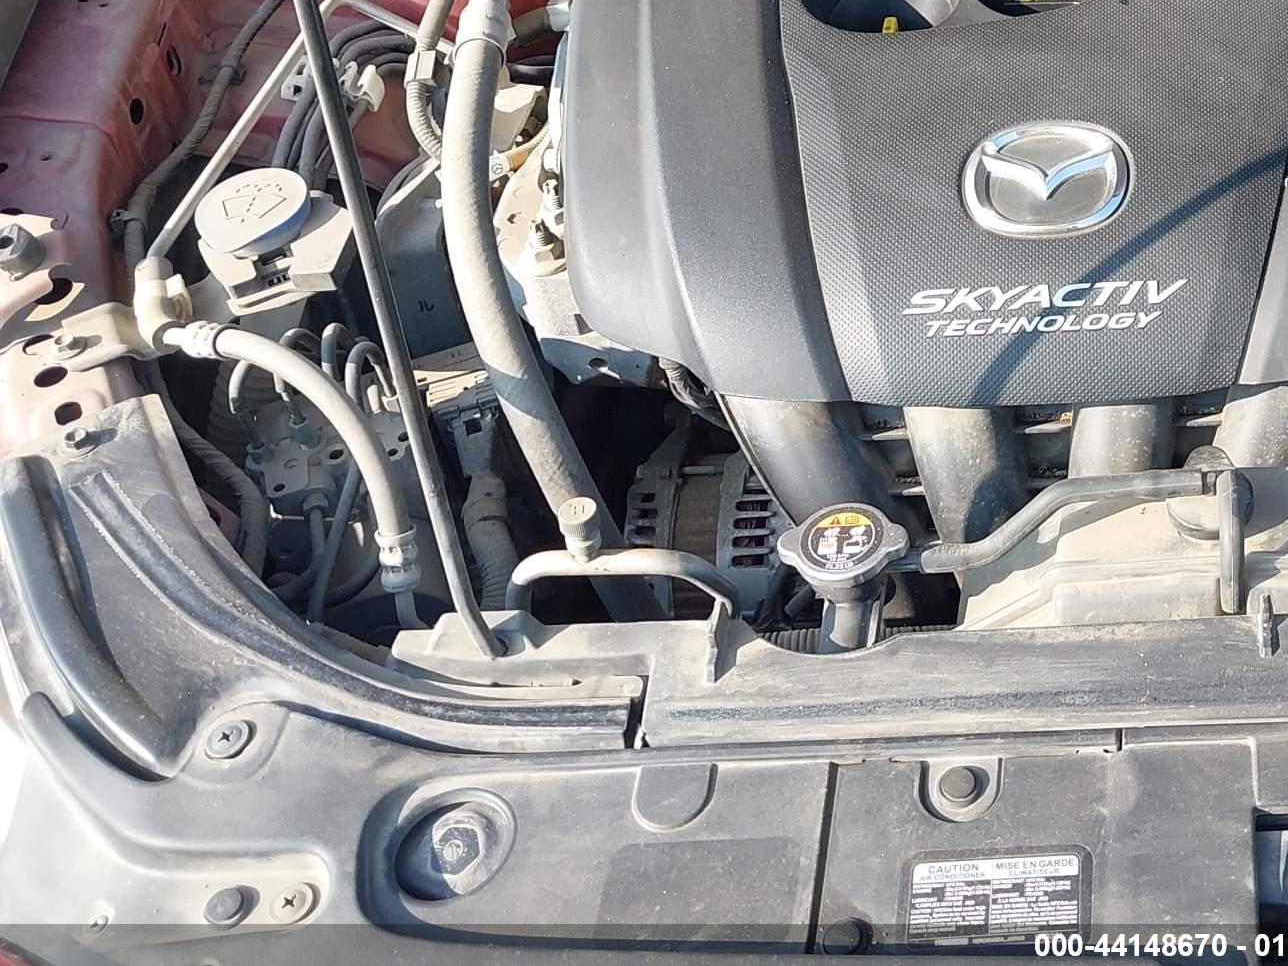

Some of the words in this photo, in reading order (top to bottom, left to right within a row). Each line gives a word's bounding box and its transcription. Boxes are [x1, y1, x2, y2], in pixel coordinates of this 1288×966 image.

[901, 278, 1190, 316] SKYACTIV
[925, 309, 1165, 338] TECHNOLOGY
[928, 863, 979, 874] CAUTION
[996, 862, 1020, 870] MISE
[1022, 860, 1037, 869] EN
[1039, 859, 1075, 867] GARDE
[934, 871, 986, 881] CONDITIONER
[1009, 868, 1060, 876] CLIMATISEUR
